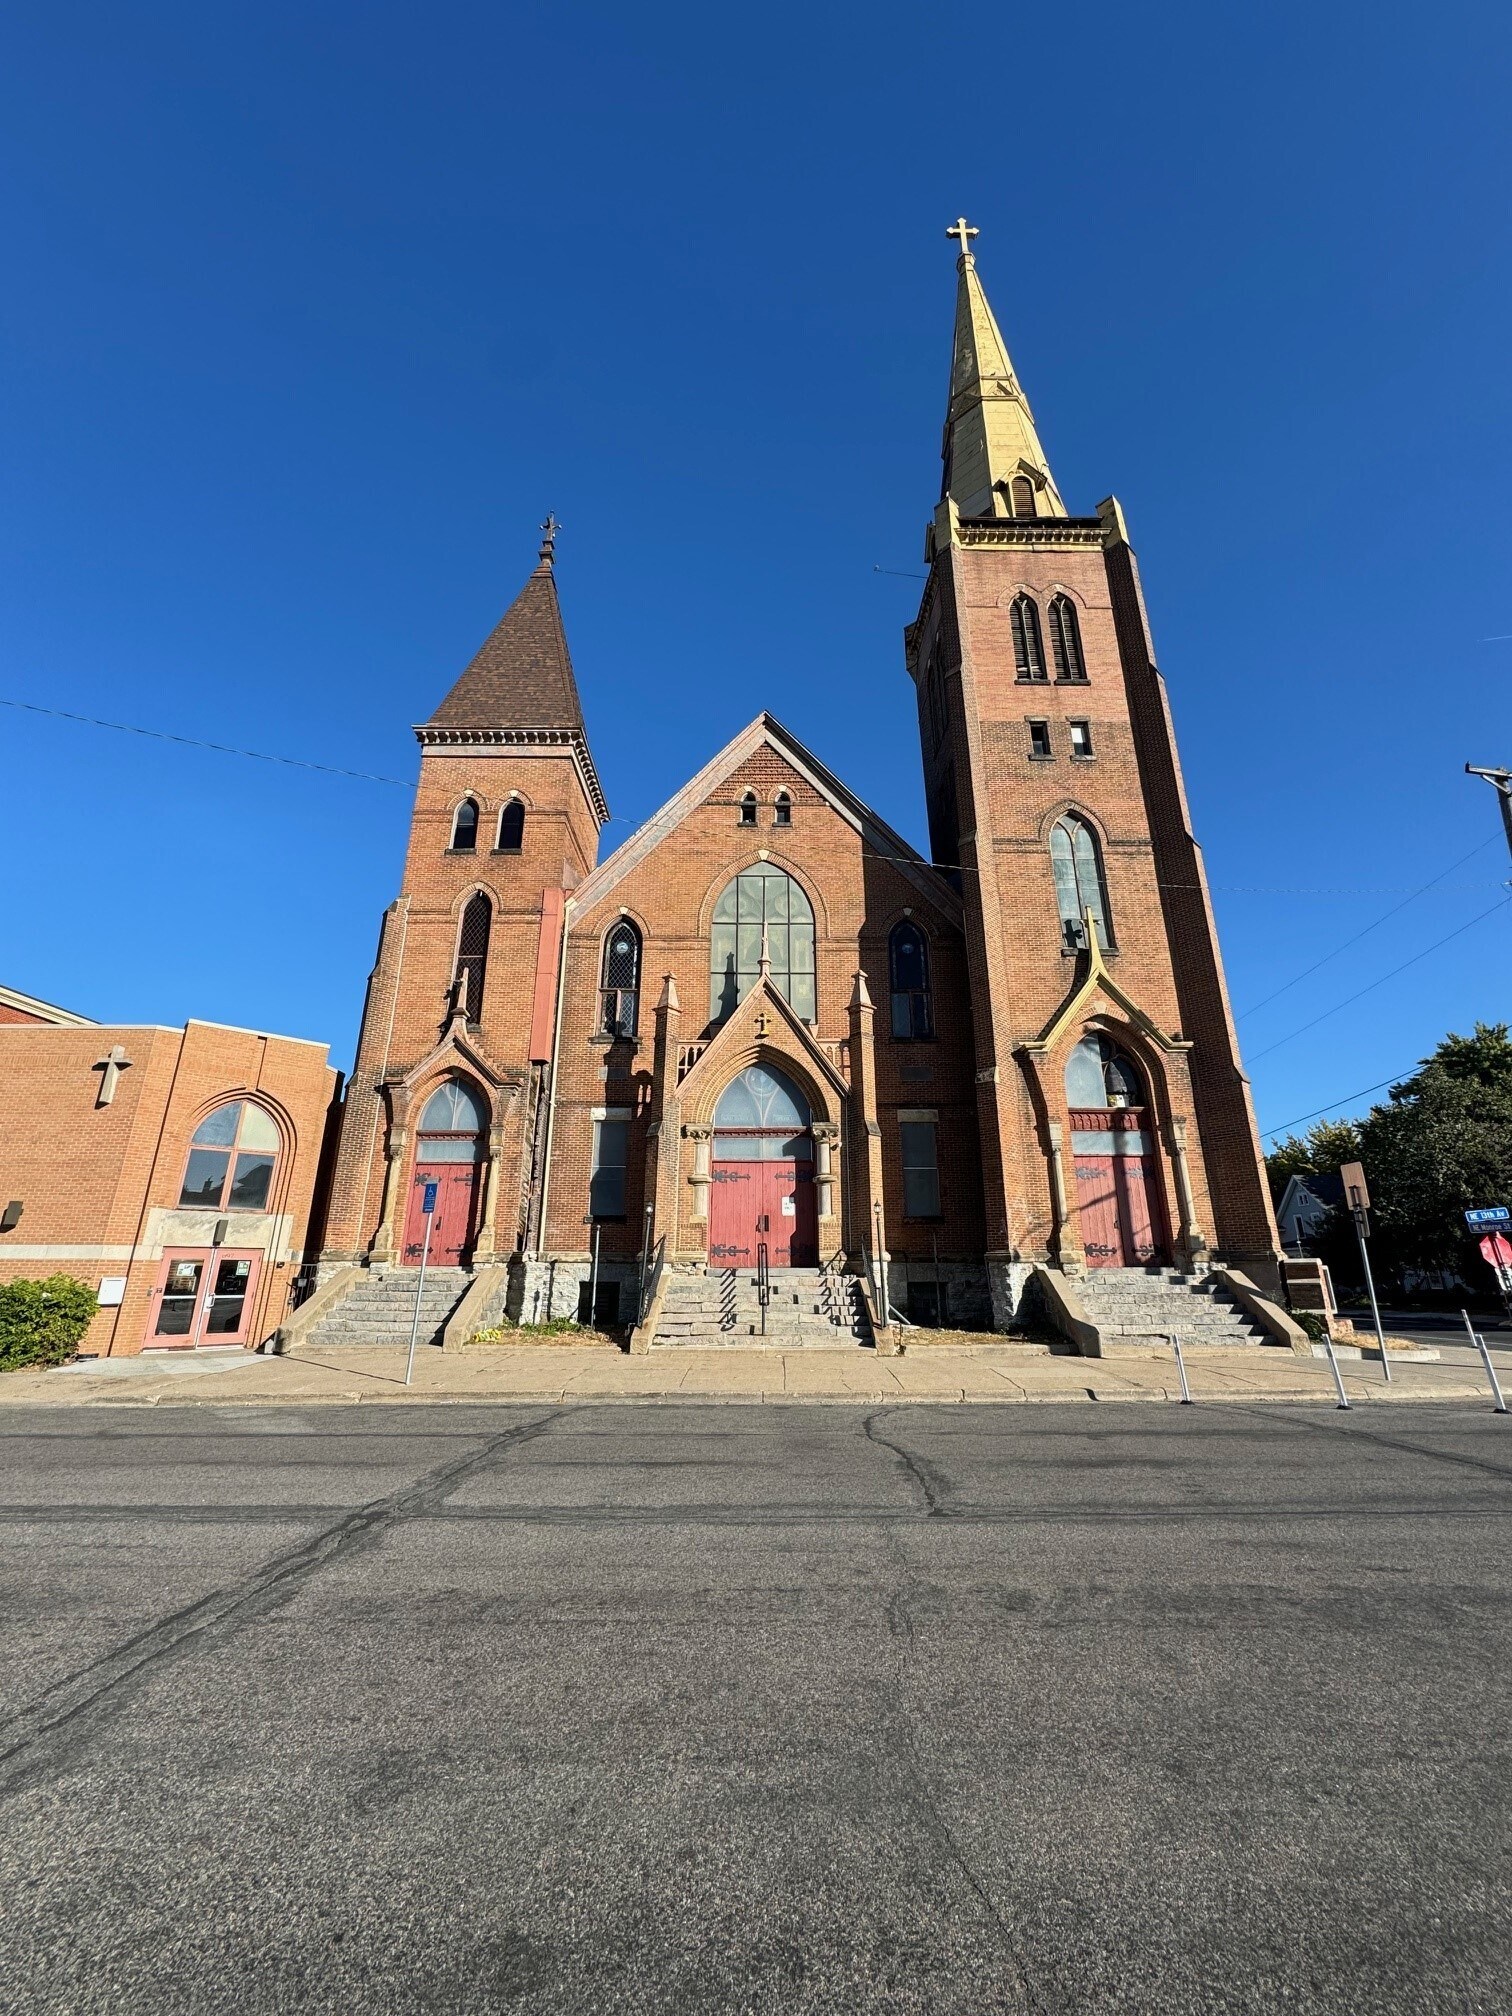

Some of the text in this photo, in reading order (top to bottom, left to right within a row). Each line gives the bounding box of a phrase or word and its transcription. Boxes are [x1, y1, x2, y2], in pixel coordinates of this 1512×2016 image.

[1469, 1212, 1479, 1220] NE
[1480, 1211, 1495, 1219] 13th
[1480, 1223, 1502, 1231] Monroe
